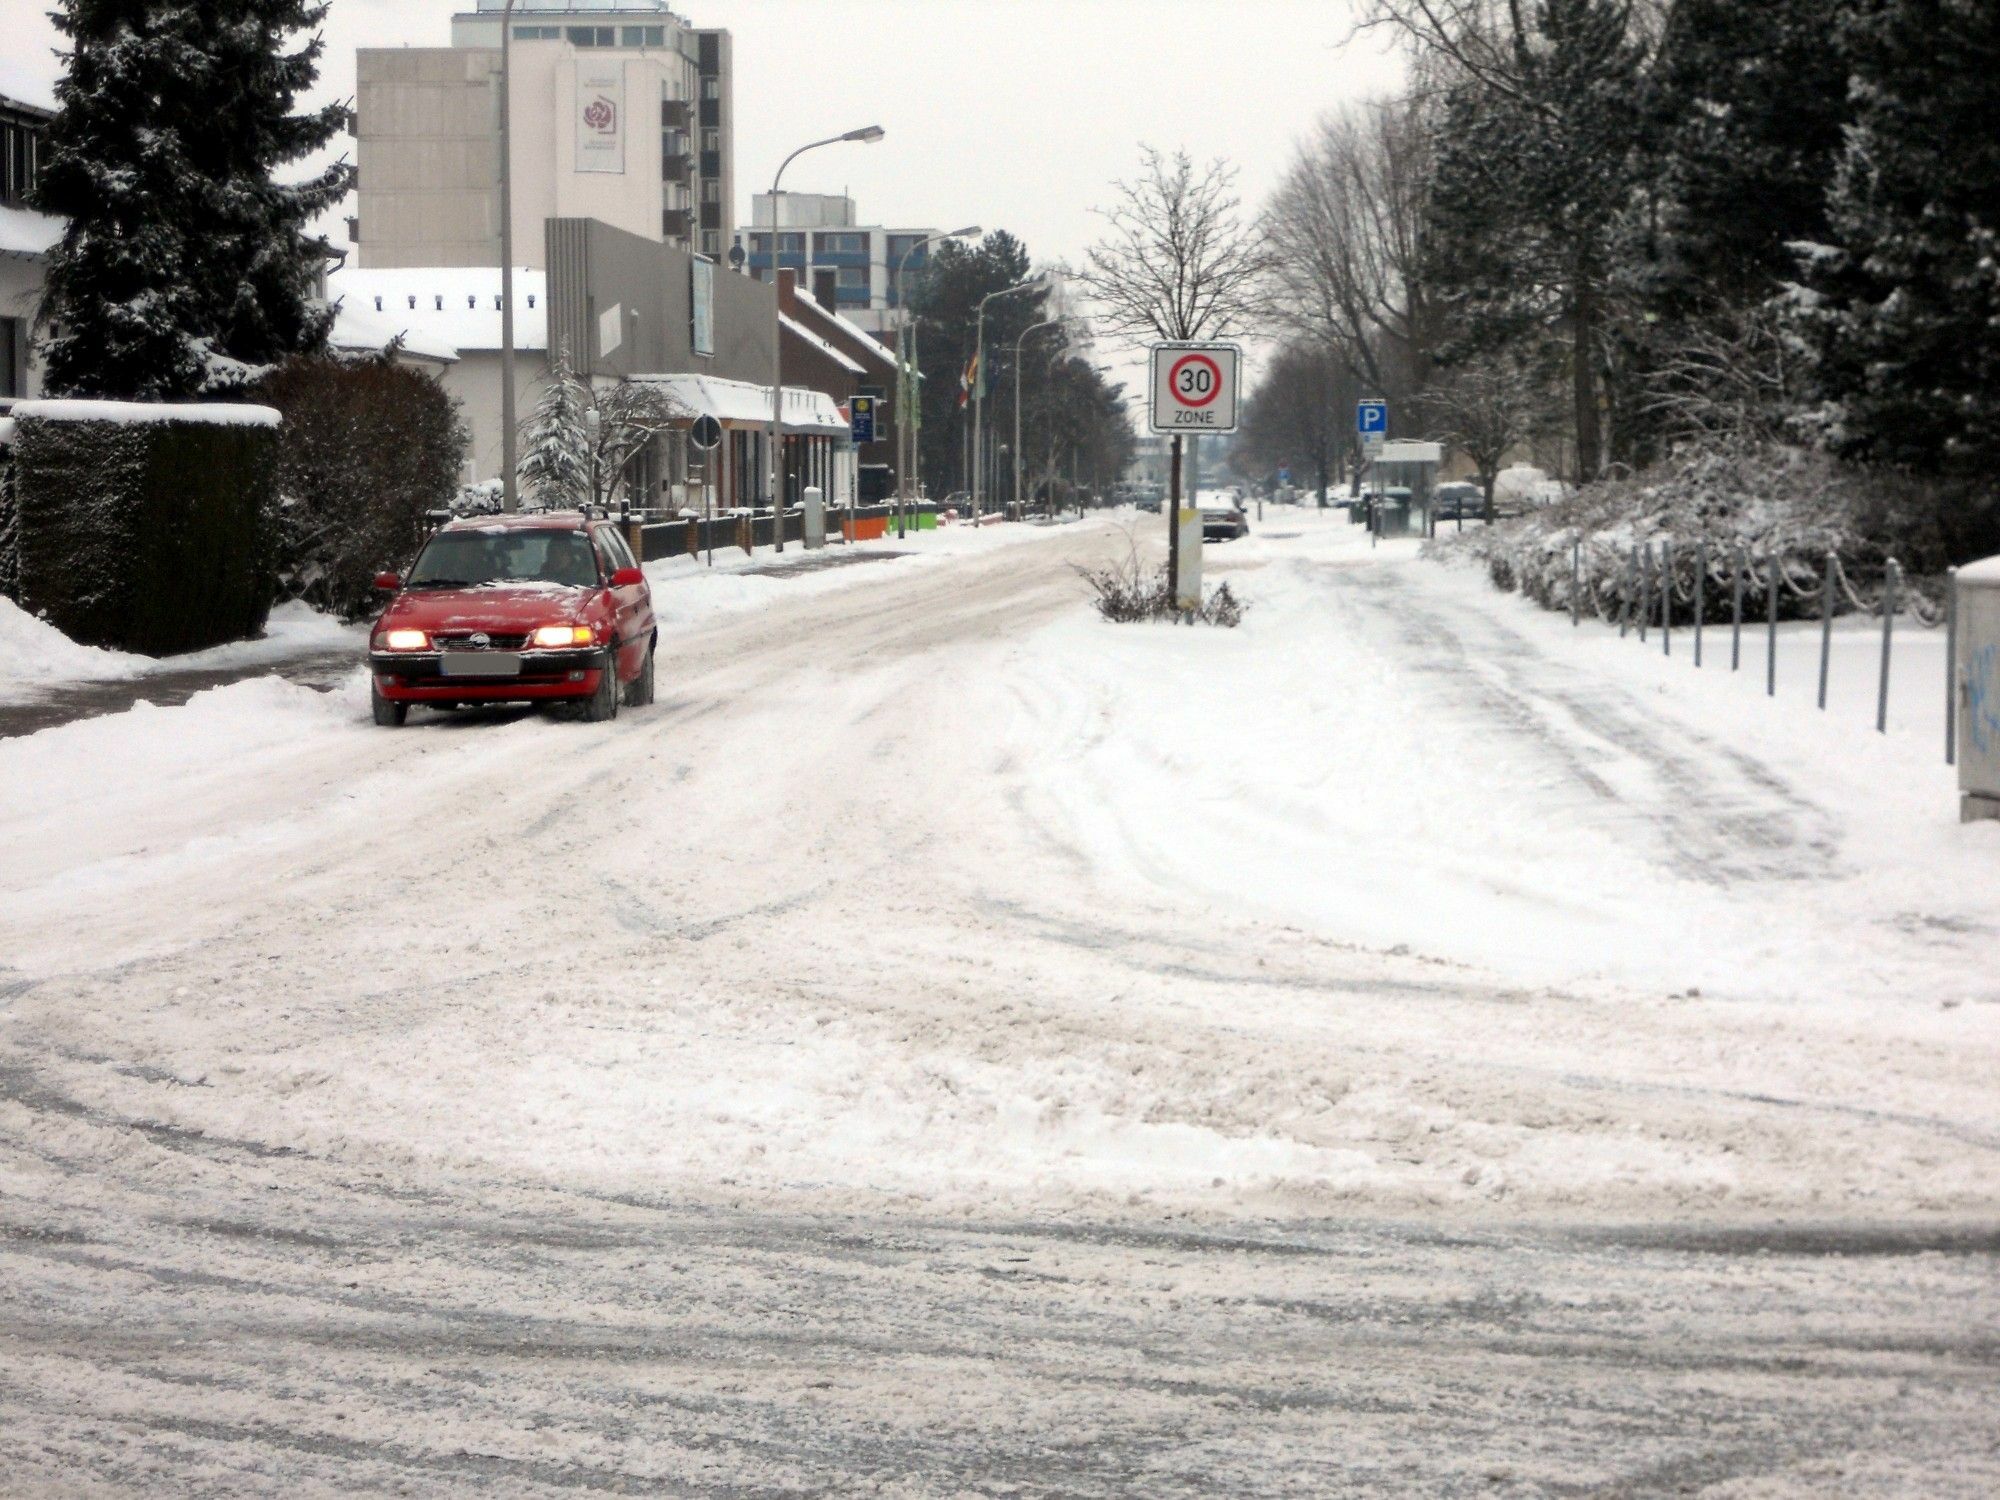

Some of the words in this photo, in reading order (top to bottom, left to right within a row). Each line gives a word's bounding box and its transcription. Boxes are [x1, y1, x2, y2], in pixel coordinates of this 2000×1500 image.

[1180, 369, 1210, 392] 30
[1174, 411, 1215, 424] ZONE
[1364, 408, 1380, 429] P
